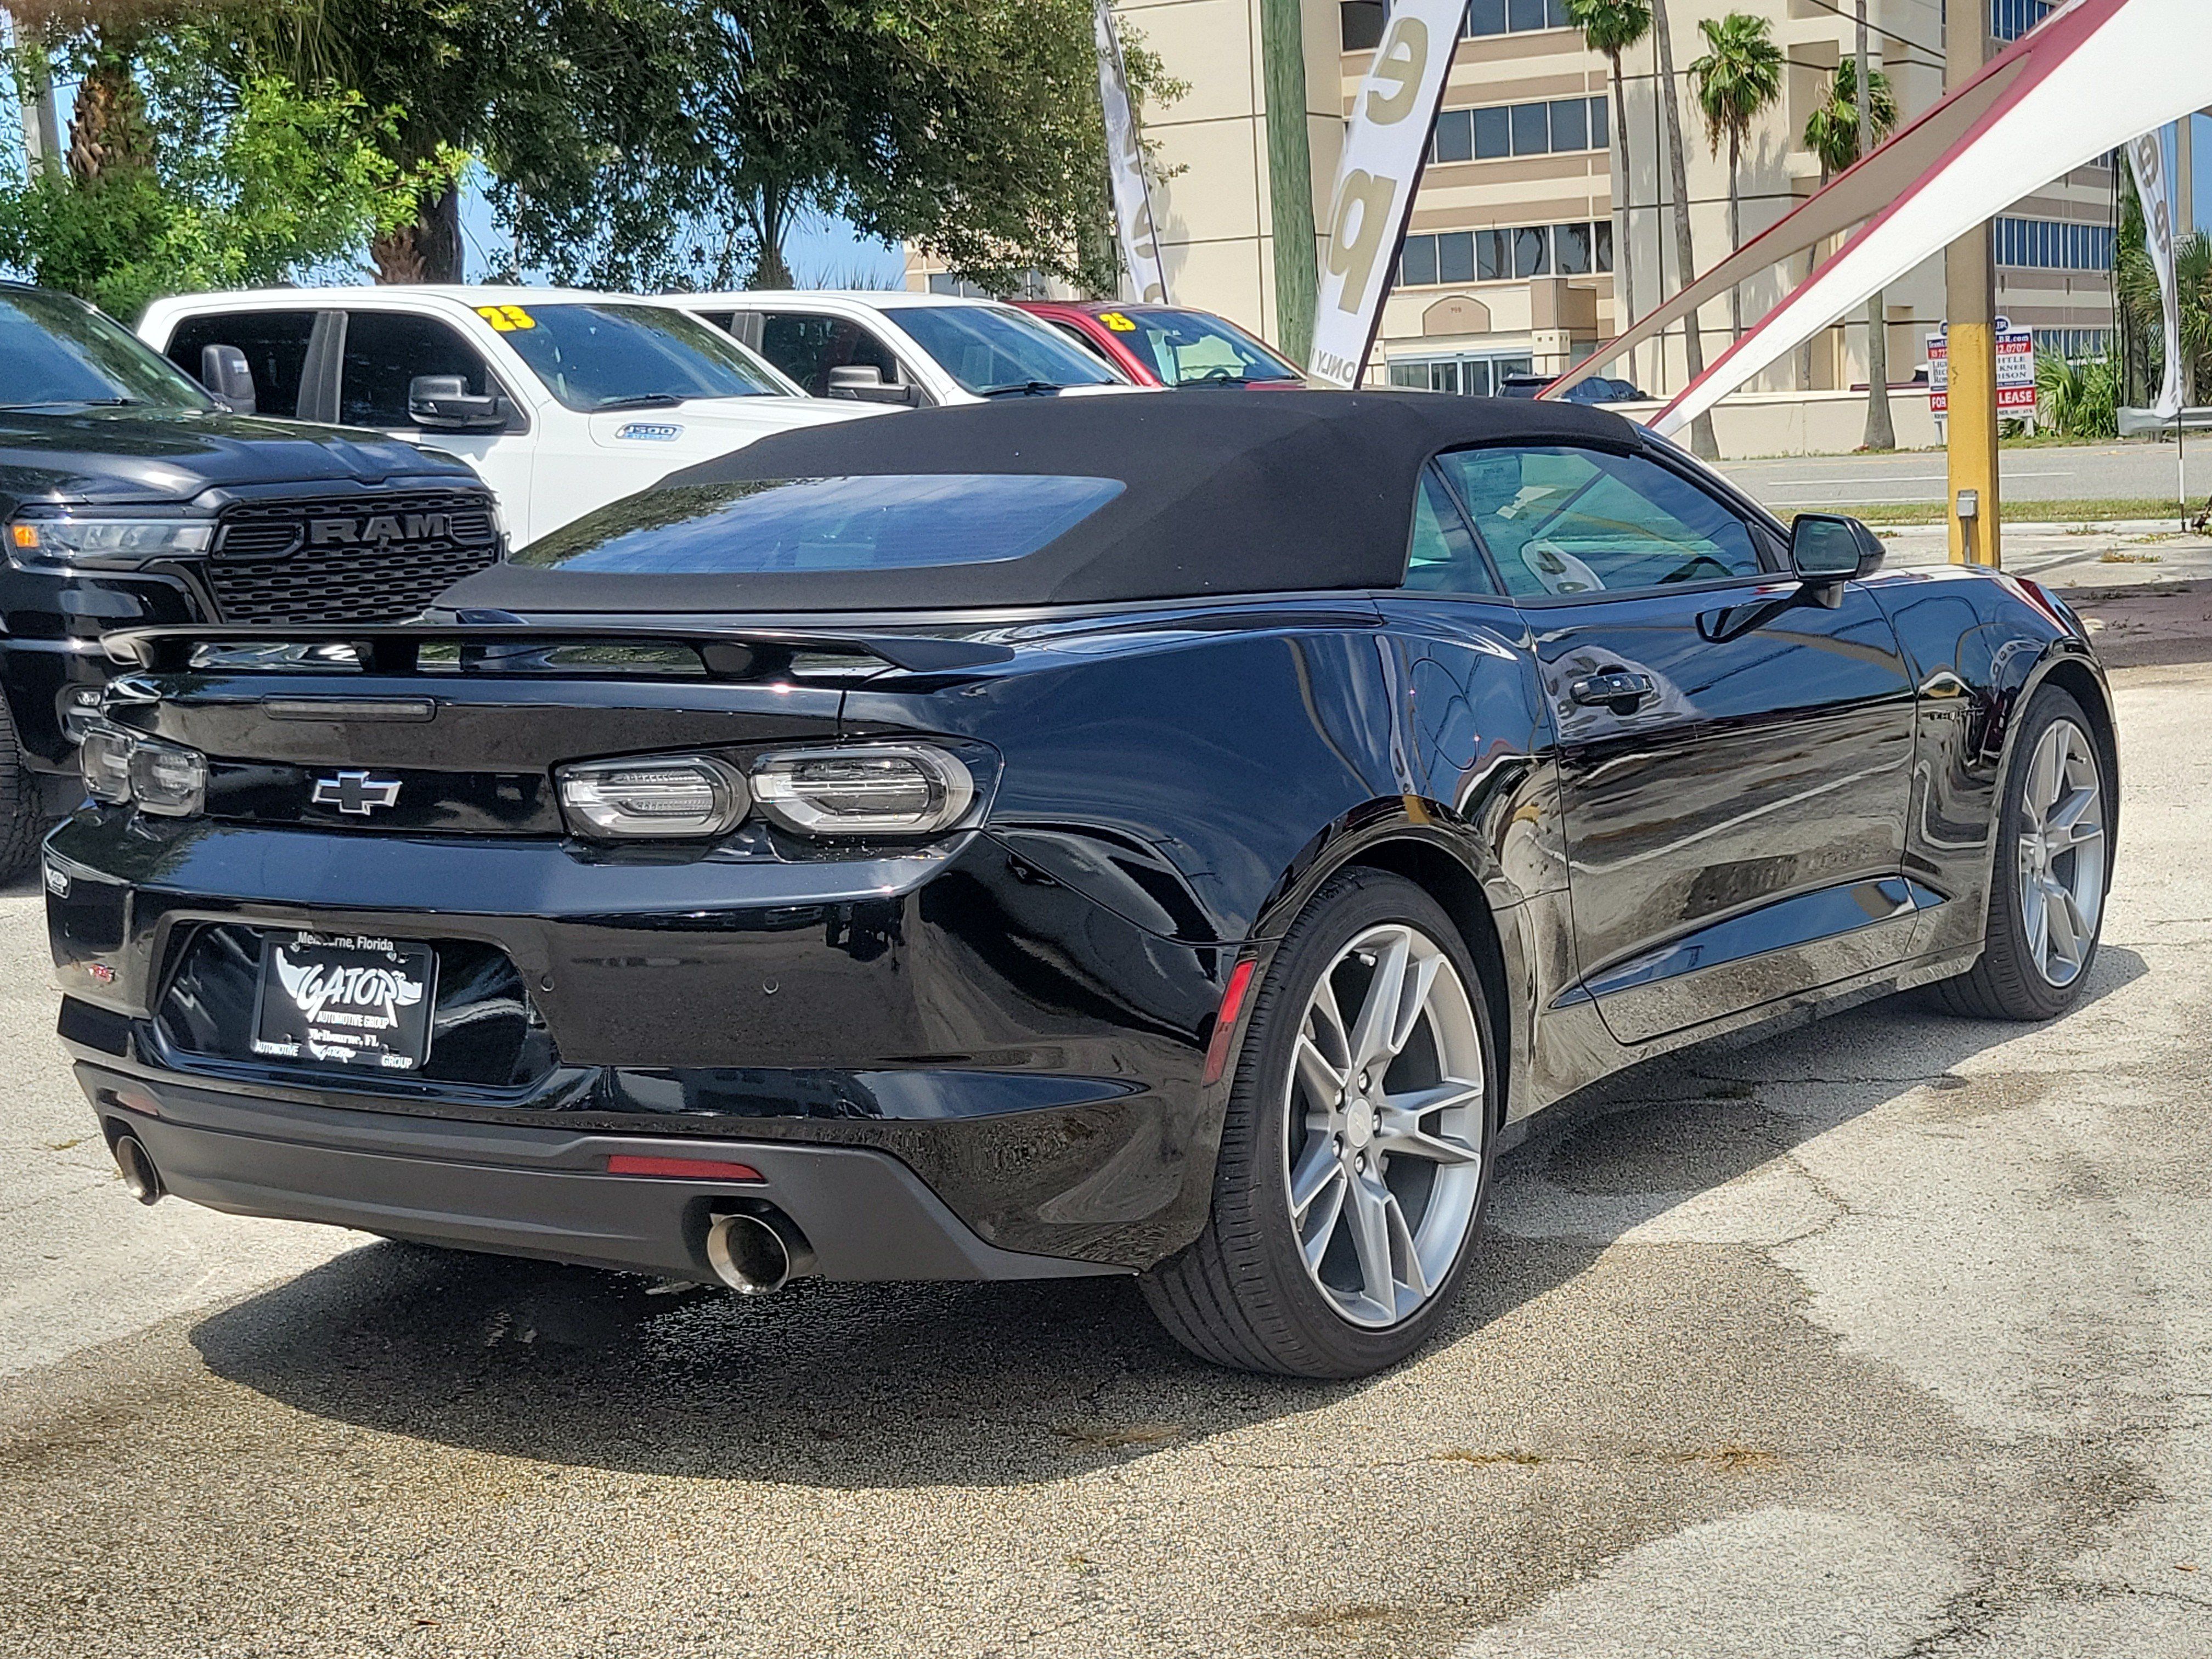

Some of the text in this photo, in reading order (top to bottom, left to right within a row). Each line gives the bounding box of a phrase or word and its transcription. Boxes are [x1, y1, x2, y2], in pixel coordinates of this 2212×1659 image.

[477, 305, 535, 331] 23
[1099, 312, 1136, 331] 25
[1932, 390, 2033, 408] FOR LEASE
[311, 513, 444, 544] RAM
[357, 935, 394, 951] Florida
[296, 963, 398, 1028] GATOR
[317, 1011, 390, 1029] AUTOMOTIVE GROUP
[255, 1040, 301, 1057] AUTOMOTIVE
[381, 1054, 413, 1069] GROUP
